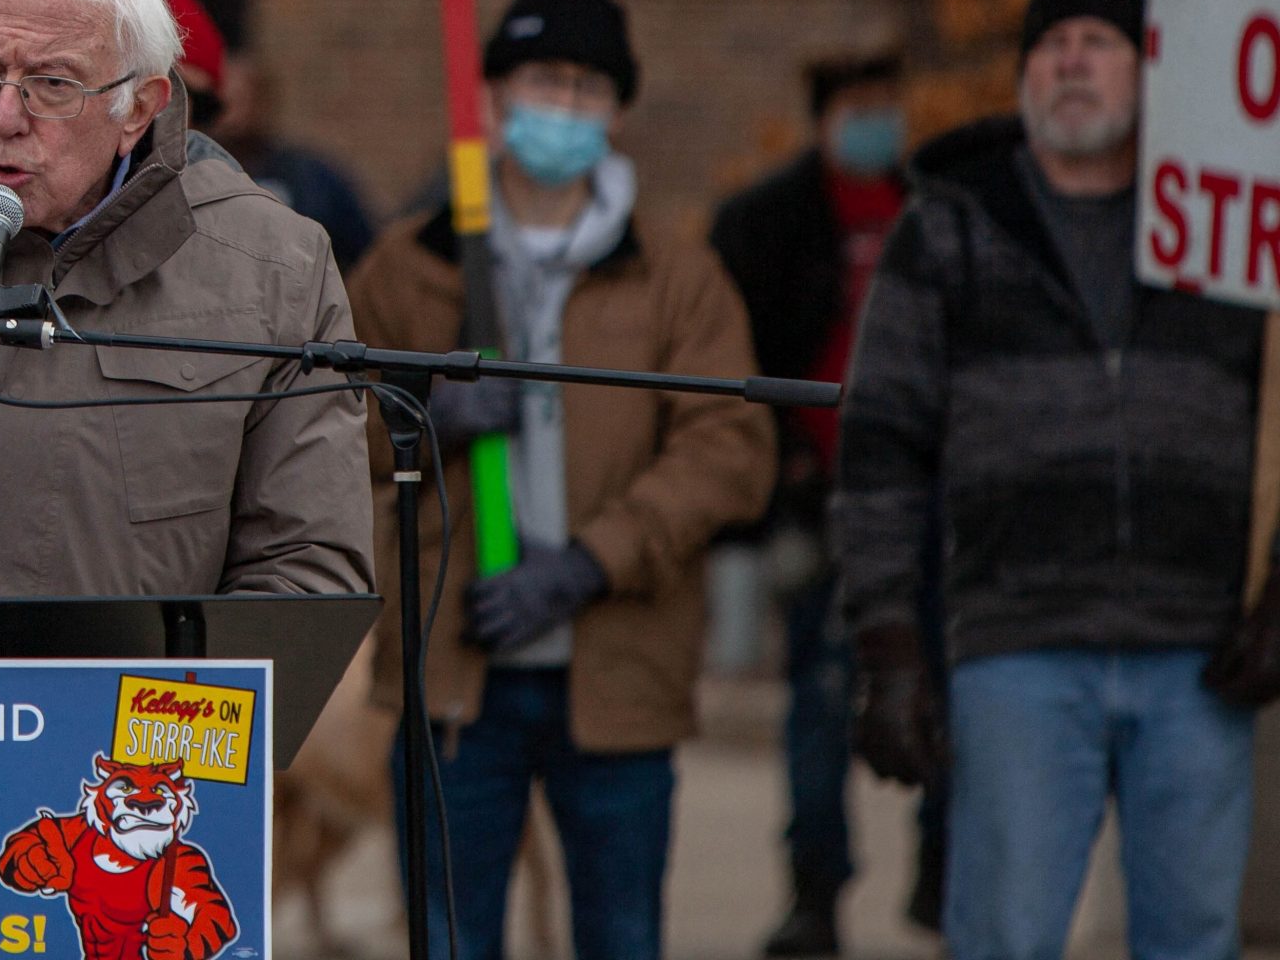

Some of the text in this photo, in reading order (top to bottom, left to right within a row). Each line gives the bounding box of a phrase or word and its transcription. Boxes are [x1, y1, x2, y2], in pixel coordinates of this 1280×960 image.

[130, 688, 242, 724] Kellogg's ON
[126, 718, 240, 770] STRRR-IKE
